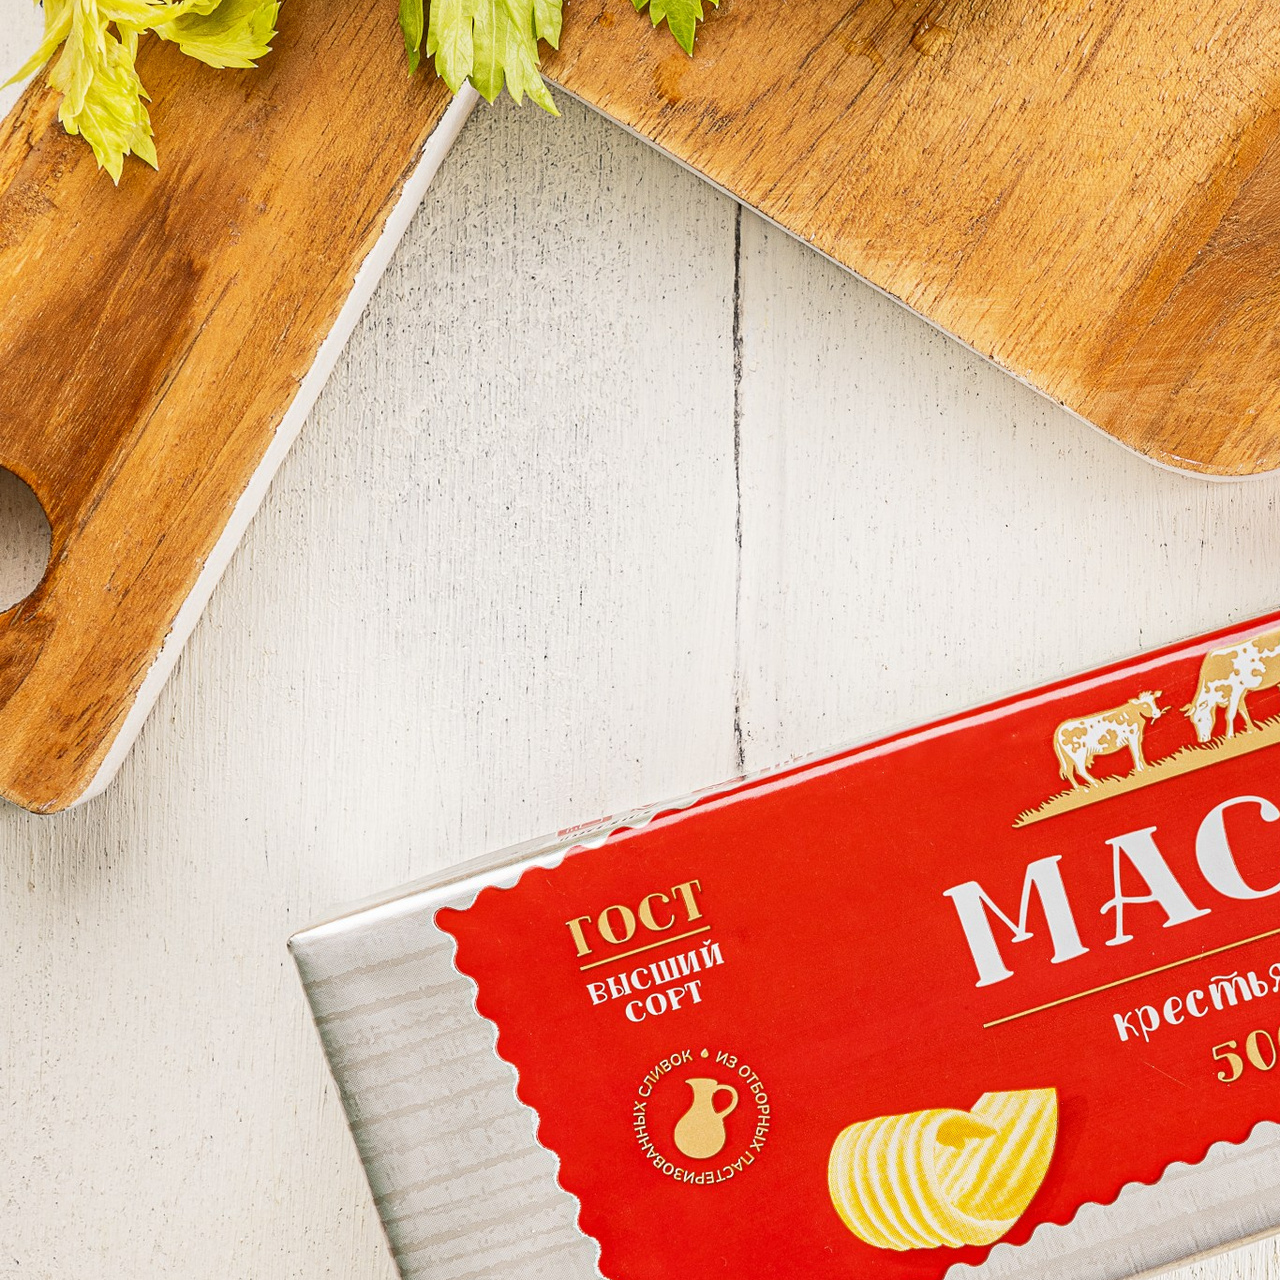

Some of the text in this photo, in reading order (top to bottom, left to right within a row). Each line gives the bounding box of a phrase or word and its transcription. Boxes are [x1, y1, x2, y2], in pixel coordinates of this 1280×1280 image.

[565, 879, 703, 957] ГОСТ
[586, 939, 725, 1005] ВЫСШИЙ
[625, 980, 702, 1023] СОРТ
[633, 1049, 771, 1184] ИЗ ОТБОРНЫХ ПАСТЕРИЗОВАННЫХ СЛИВОК
